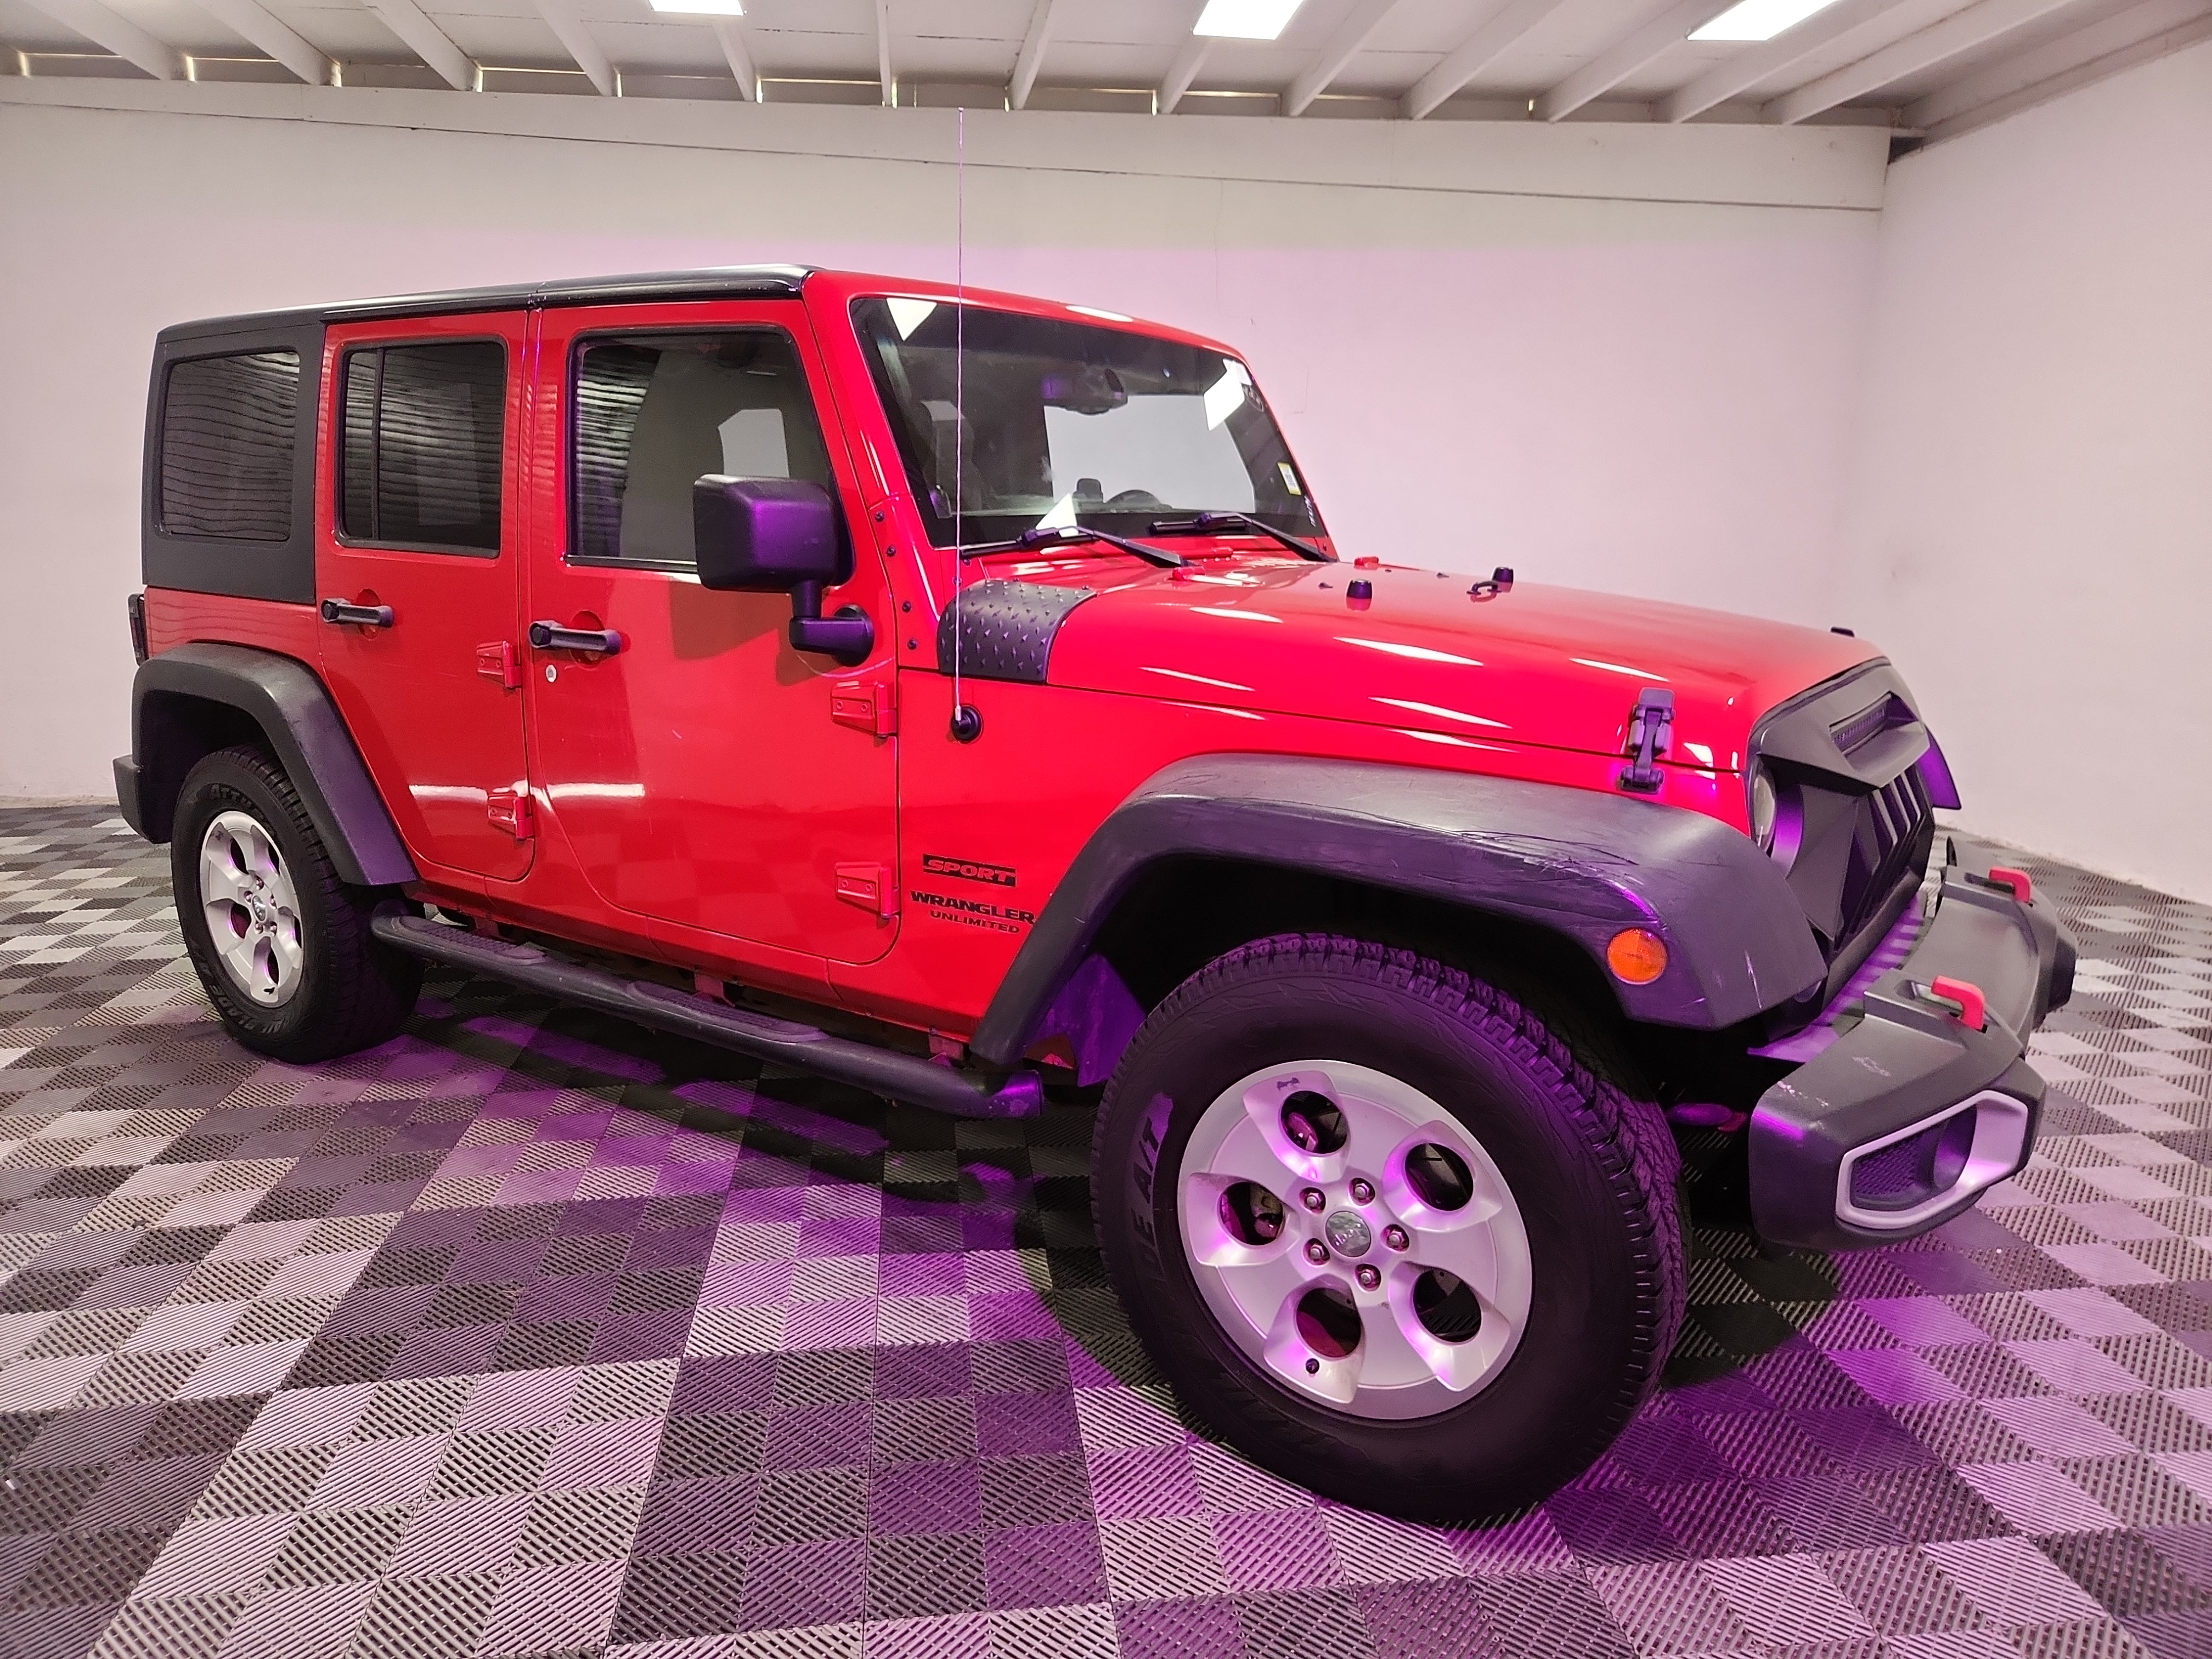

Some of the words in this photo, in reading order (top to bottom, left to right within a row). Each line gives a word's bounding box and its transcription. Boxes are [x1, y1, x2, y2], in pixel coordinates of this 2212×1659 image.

[926, 859, 1016, 882] SPORT
[910, 890, 1036, 924] WRANGLER
[930, 910, 1020, 934] UNLIMITED
[1131, 1117, 1159, 1204] A/T
